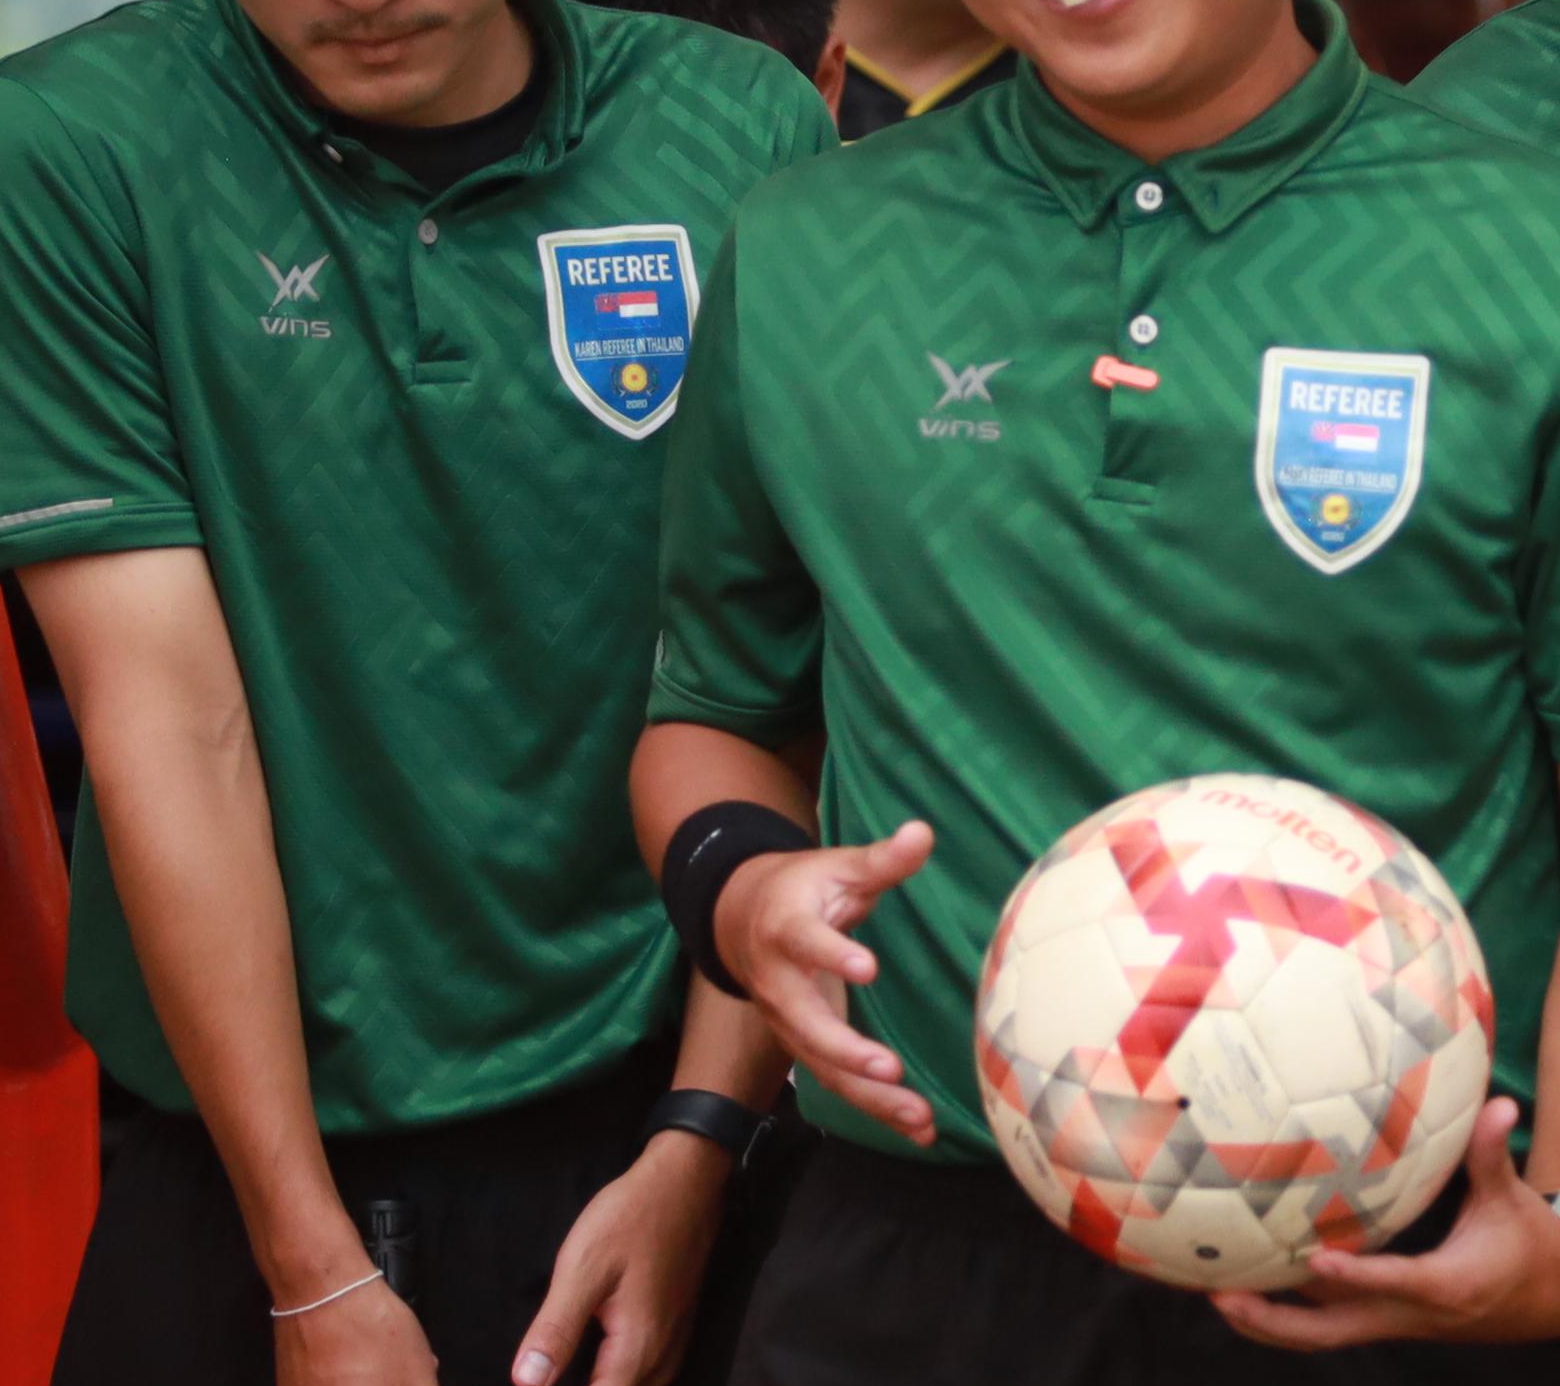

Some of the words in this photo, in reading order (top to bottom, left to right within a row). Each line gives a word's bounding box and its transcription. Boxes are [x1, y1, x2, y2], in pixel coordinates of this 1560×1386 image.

[567, 254, 674, 286] REFEREE
[602, 338, 636, 356] REFEREE
[637, 337, 646, 354] IN
[646, 336, 684, 353] THAILAND
[1289, 381, 1404, 419] REFEREE
[1200, 789, 1363, 875] molten
